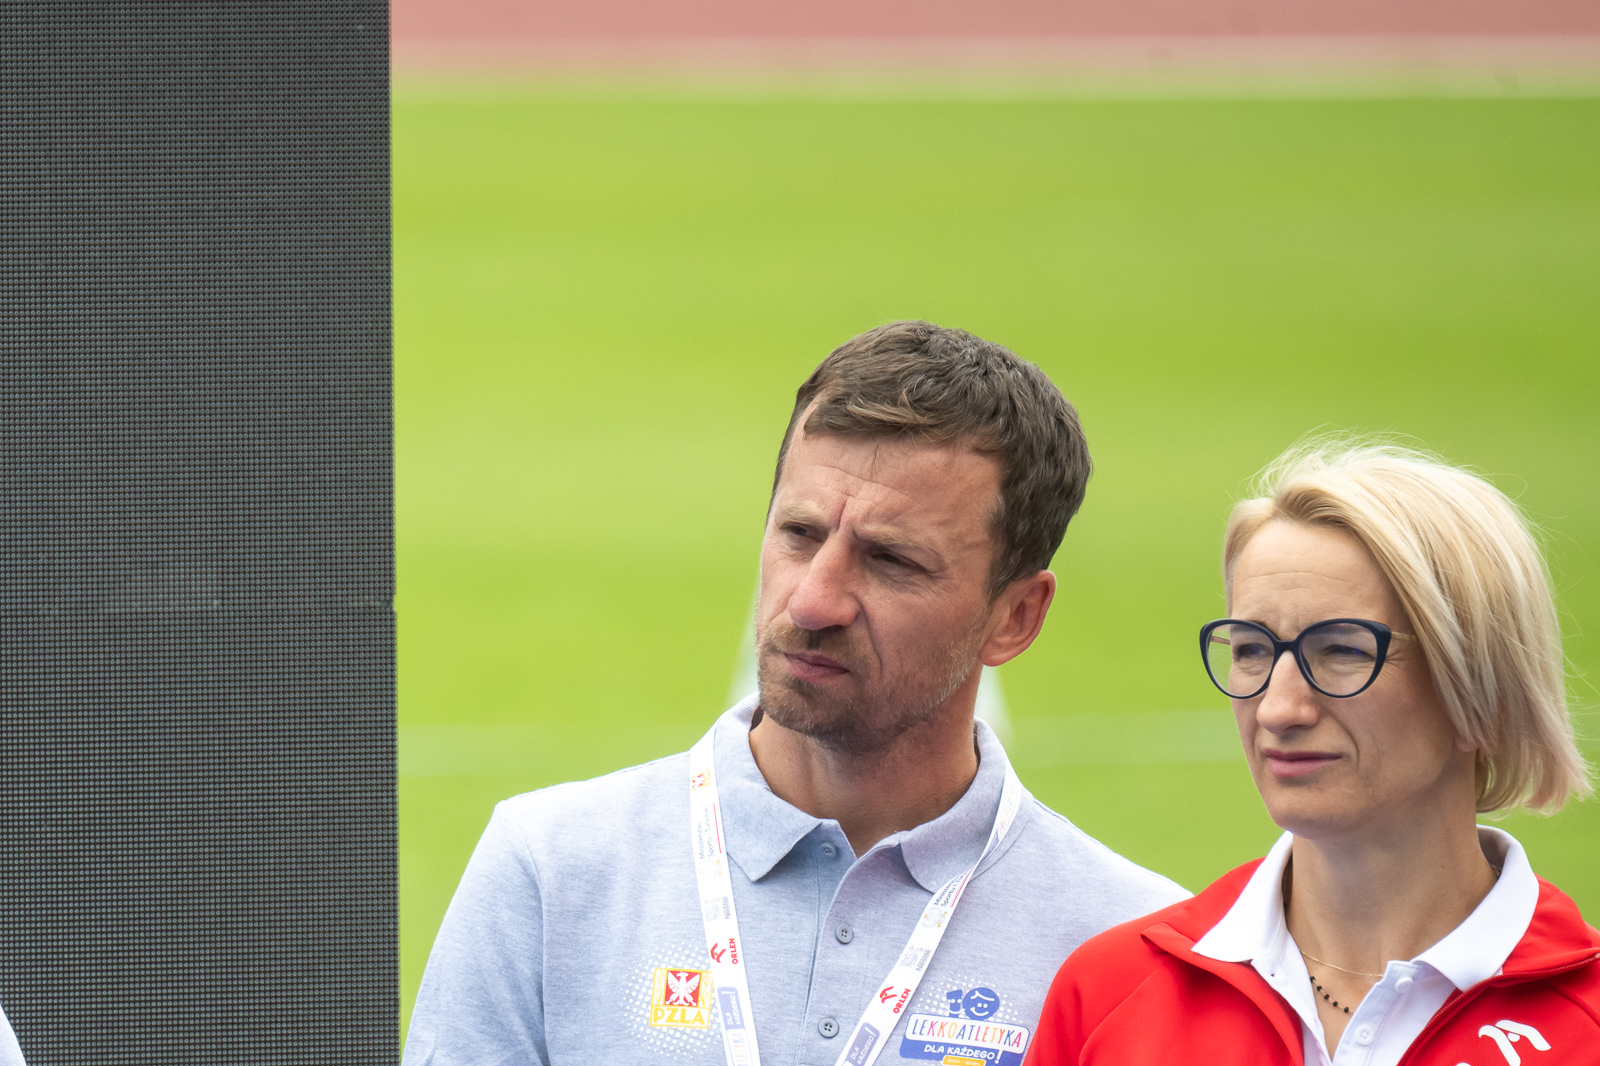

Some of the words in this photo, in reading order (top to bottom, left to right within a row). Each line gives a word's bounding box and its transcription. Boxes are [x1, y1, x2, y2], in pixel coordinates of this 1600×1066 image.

[728, 938, 738, 965] ORLEN
[893, 988, 911, 1014] ORLEN
[652, 1007, 705, 1026] PZLA
[911, 1018, 1022, 1048] LEKKOATLETYKA
[850, 1046, 860, 1061] DLA
[923, 1044, 945, 1054] DLA
[947, 1047, 1003, 1064] KAŻDEGO!
